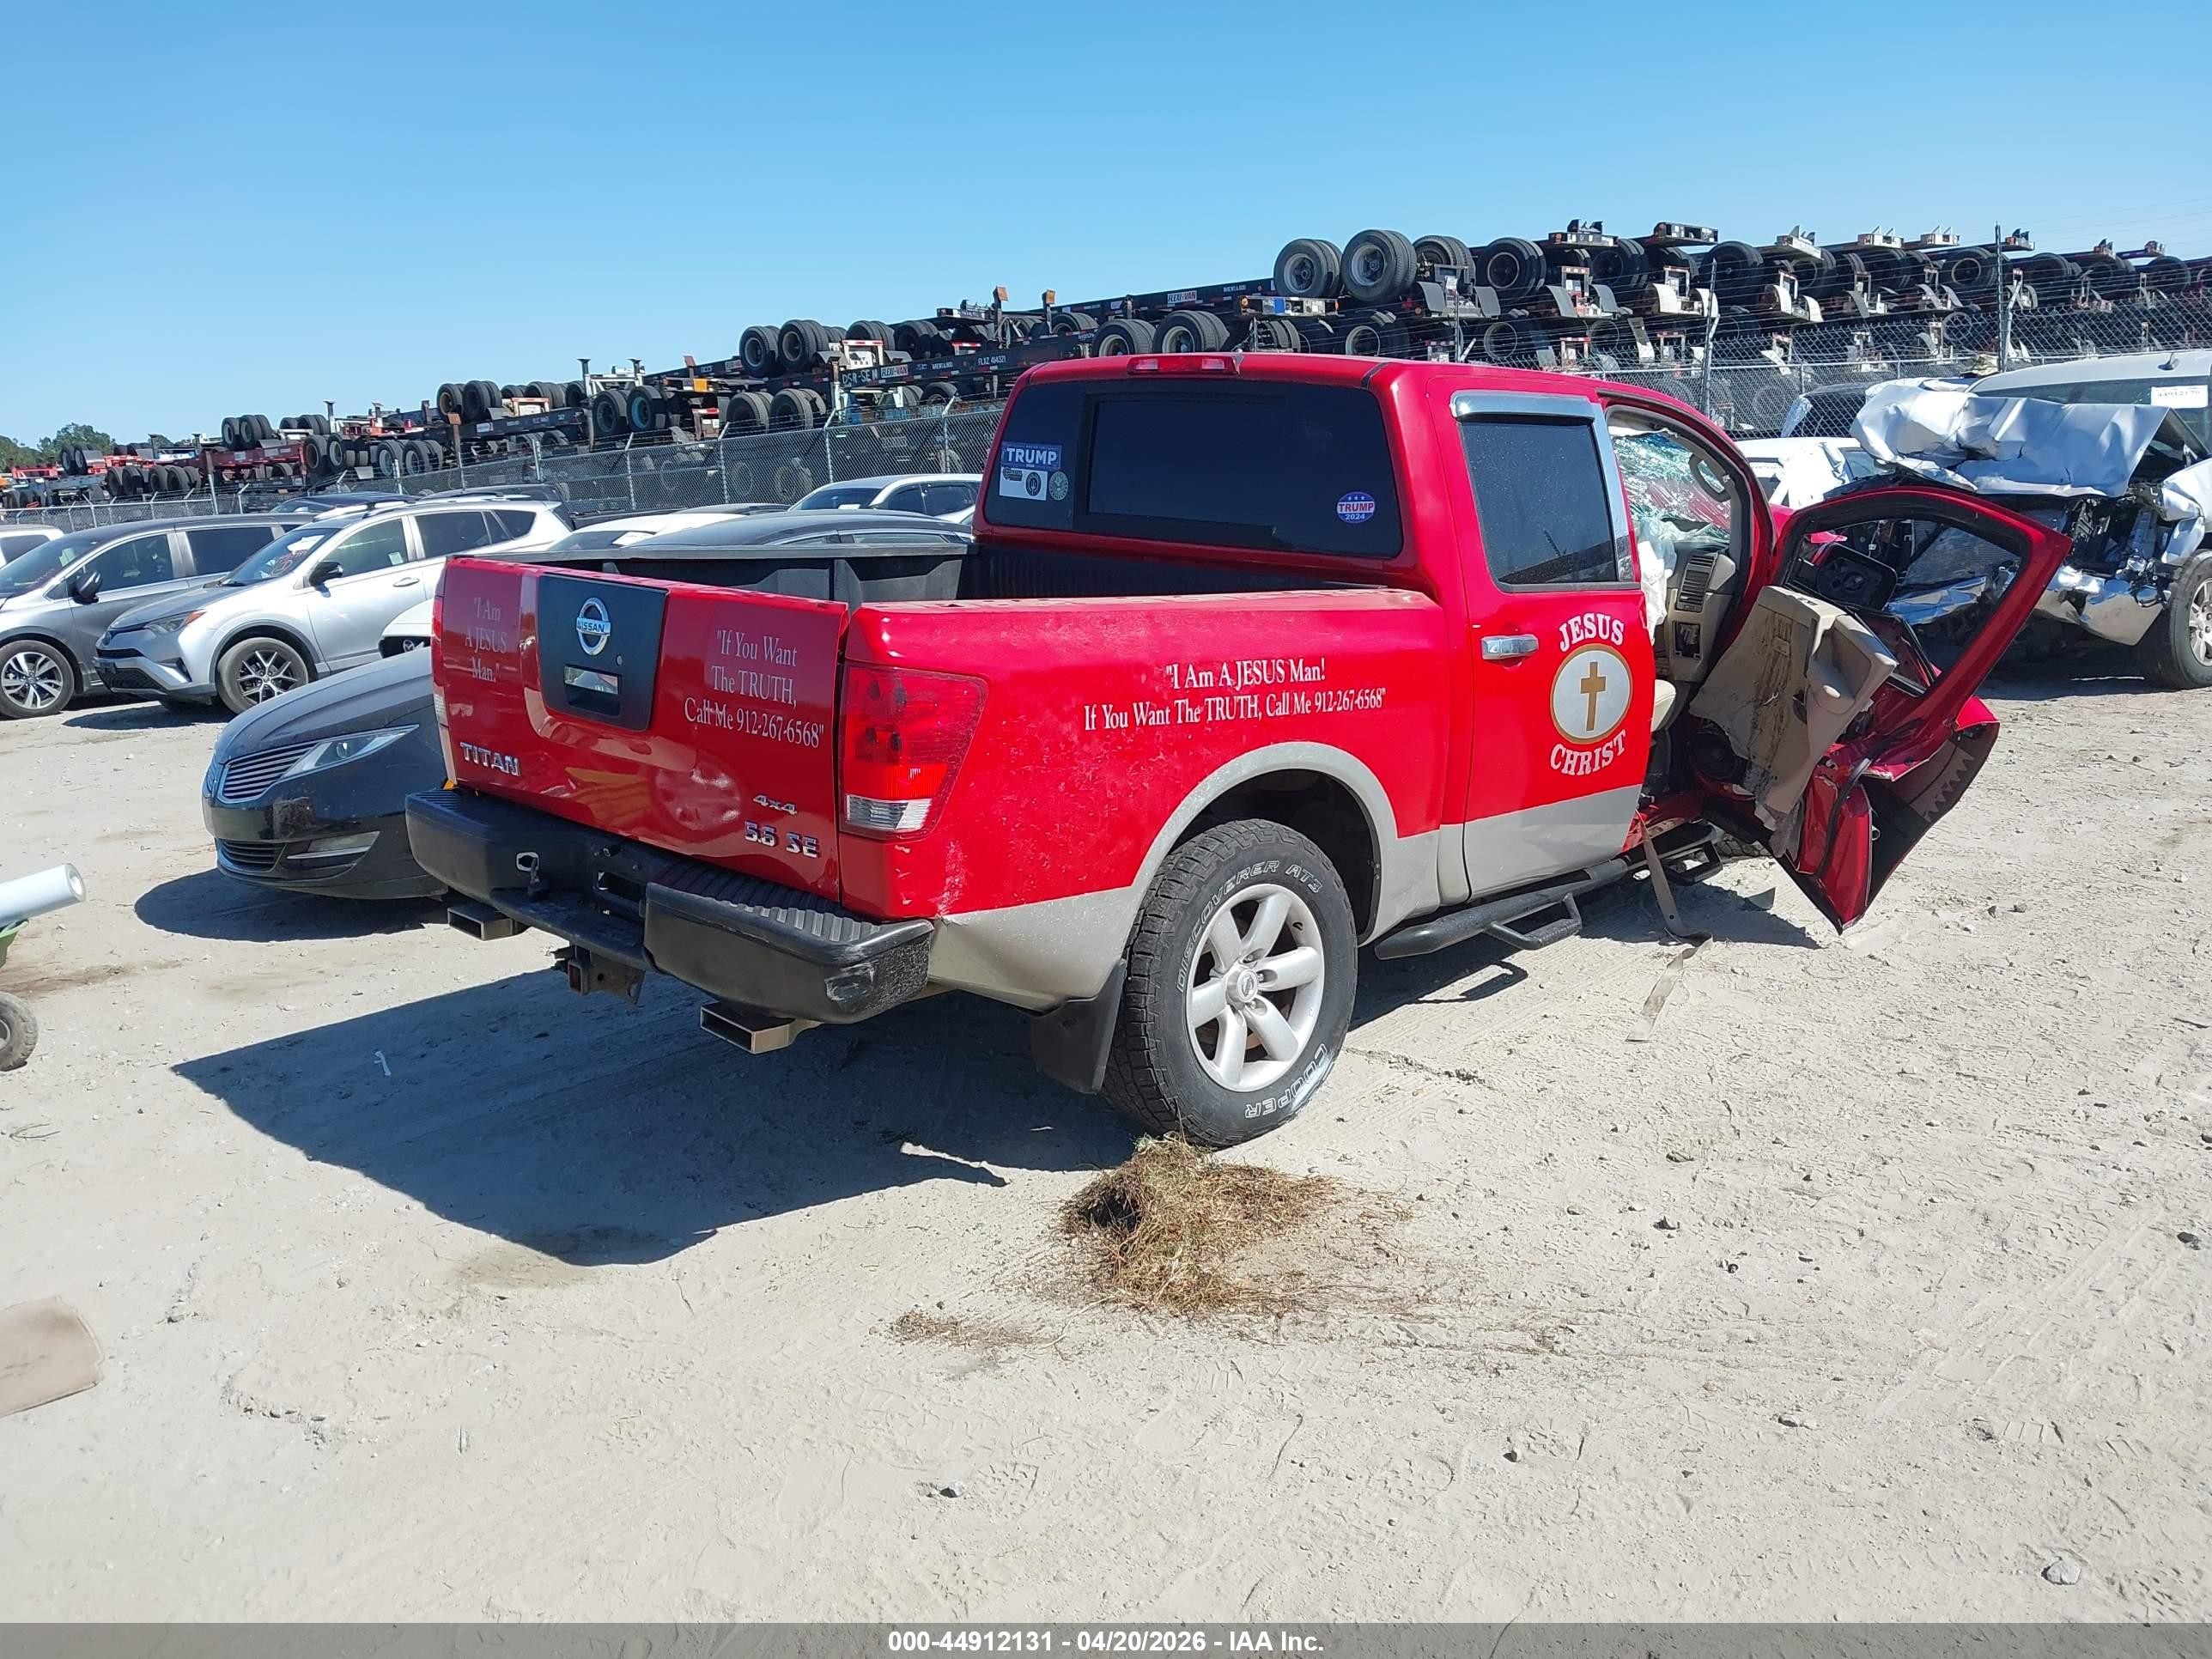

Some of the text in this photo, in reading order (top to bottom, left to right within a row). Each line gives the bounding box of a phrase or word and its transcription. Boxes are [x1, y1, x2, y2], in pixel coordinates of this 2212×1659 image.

[1006, 447, 1057, 465] TRUMP
[1339, 502, 1374, 513] TRUMP
[484, 599, 501, 622] Am
[577, 620, 605, 633] NISSAN
[465, 626, 507, 654] A JESUS
[717, 629, 798, 667] "If You Want
[1559, 612, 1624, 652] JESUS
[473, 657, 500, 684] Man."
[712, 665, 797, 709] The TRUTH,
[1165, 657, 1325, 691] "I Am A JESUS Man!
[684, 696, 824, 748] Call Me 912-267-6568"
[1085, 687, 1387, 730] If You Want The TRUTH, Call Me 912-267-6568"
[460, 742, 521, 777] TITAN
[1550, 729, 1626, 776] CHRIST
[753, 794, 797, 816] 4x4
[744, 820, 819, 858] 5.6 SE
[1176, 860, 1323, 993] DISCOVERER AT3
[1245, 1043, 1328, 1119] COOPER
